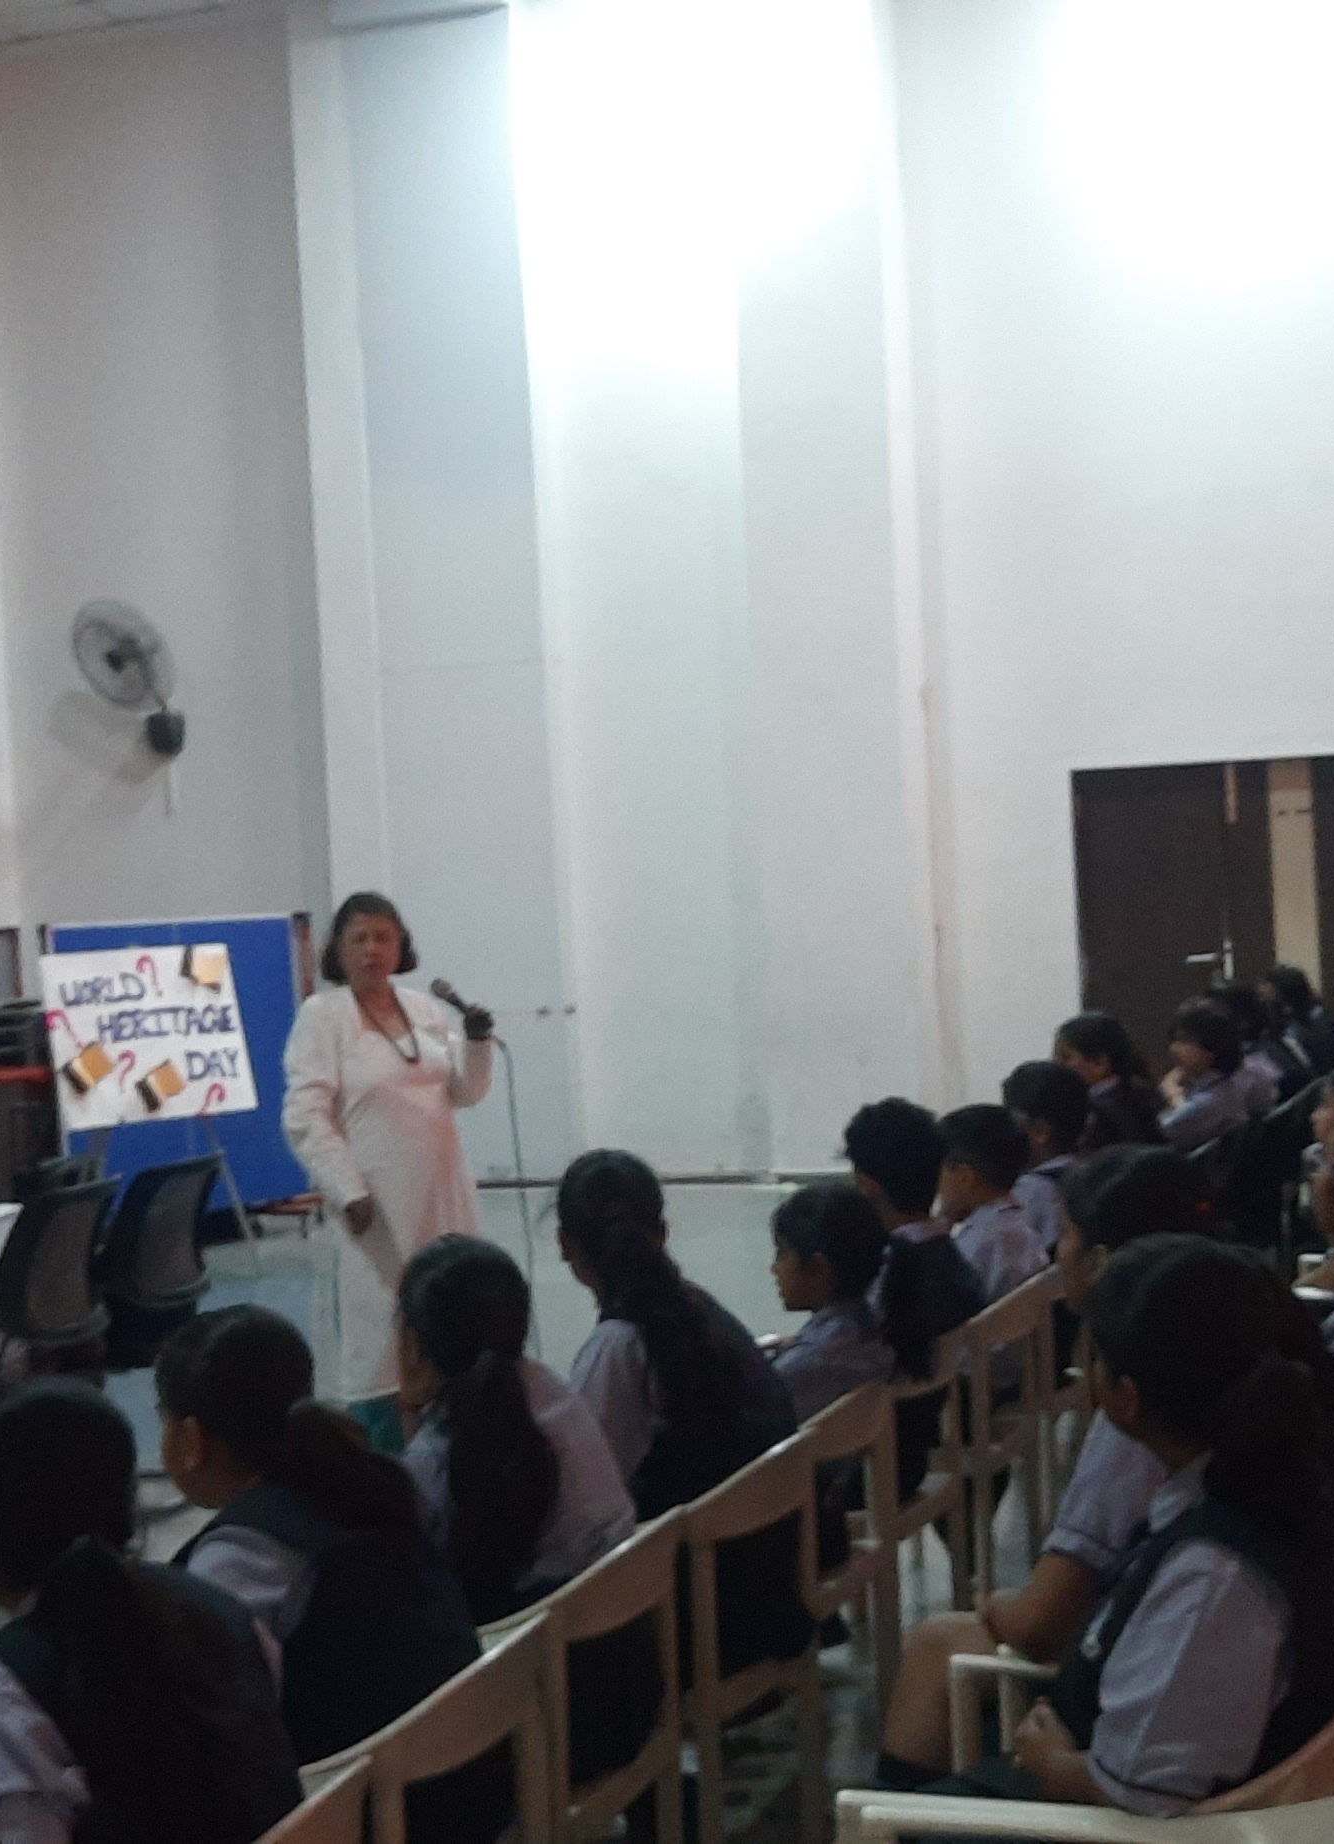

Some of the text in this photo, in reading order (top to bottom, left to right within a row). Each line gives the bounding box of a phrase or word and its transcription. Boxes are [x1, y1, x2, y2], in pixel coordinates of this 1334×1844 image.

[59, 973, 145, 1006] WORLD
[97, 1004, 236, 1043] HERITAGE
[185, 1048, 239, 1081] DAY
